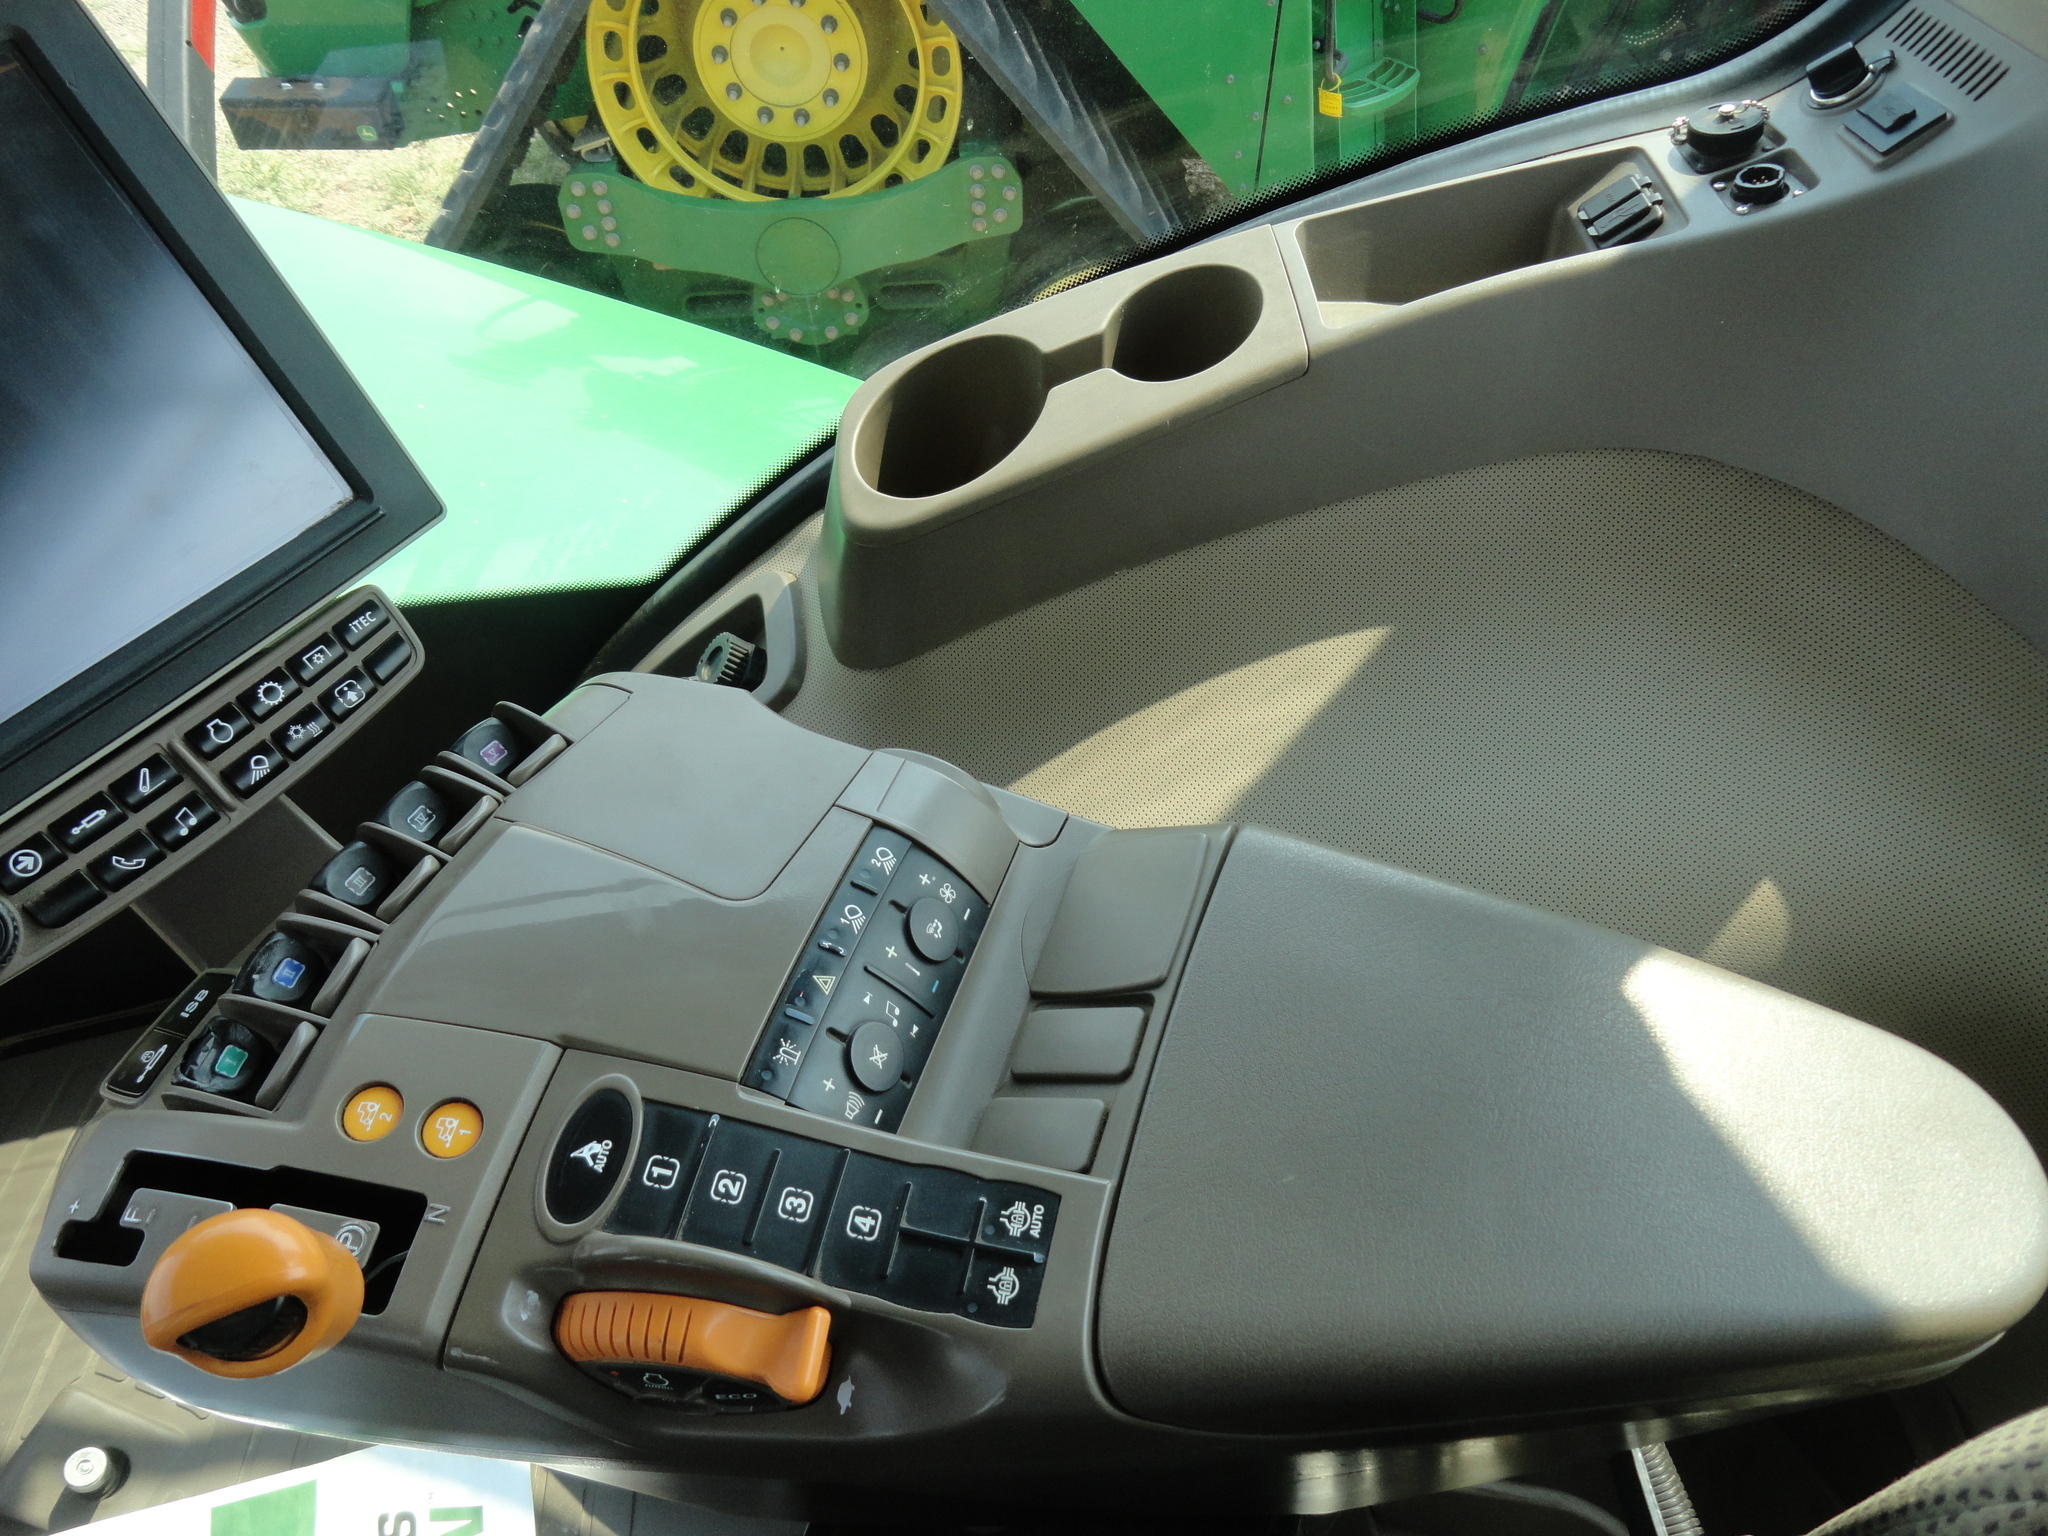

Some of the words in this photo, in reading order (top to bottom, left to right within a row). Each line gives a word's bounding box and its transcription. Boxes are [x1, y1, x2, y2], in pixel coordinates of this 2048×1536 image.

[348, 611, 377, 634] iTEC
[487, 748, 500, 760] V
[414, 812, 430, 826] IV
[871, 859, 881, 867] 2
[353, 876, 368, 889] III
[840, 917, 851, 925] 1
[282, 967, 296, 980] II
[180, 988, 209, 1018] ISB
[378, 1111, 393, 1122] 2
[458, 1128, 472, 1136] 1
[593, 1139, 613, 1173] AUTO
[651, 1165, 673, 1178] 1
[717, 1178, 741, 1197] 2
[785, 1196, 808, 1214] 3
[423, 1202, 451, 1225] N
[853, 1215, 877, 1233] 4
[1028, 1203, 1046, 1239] AUTO
